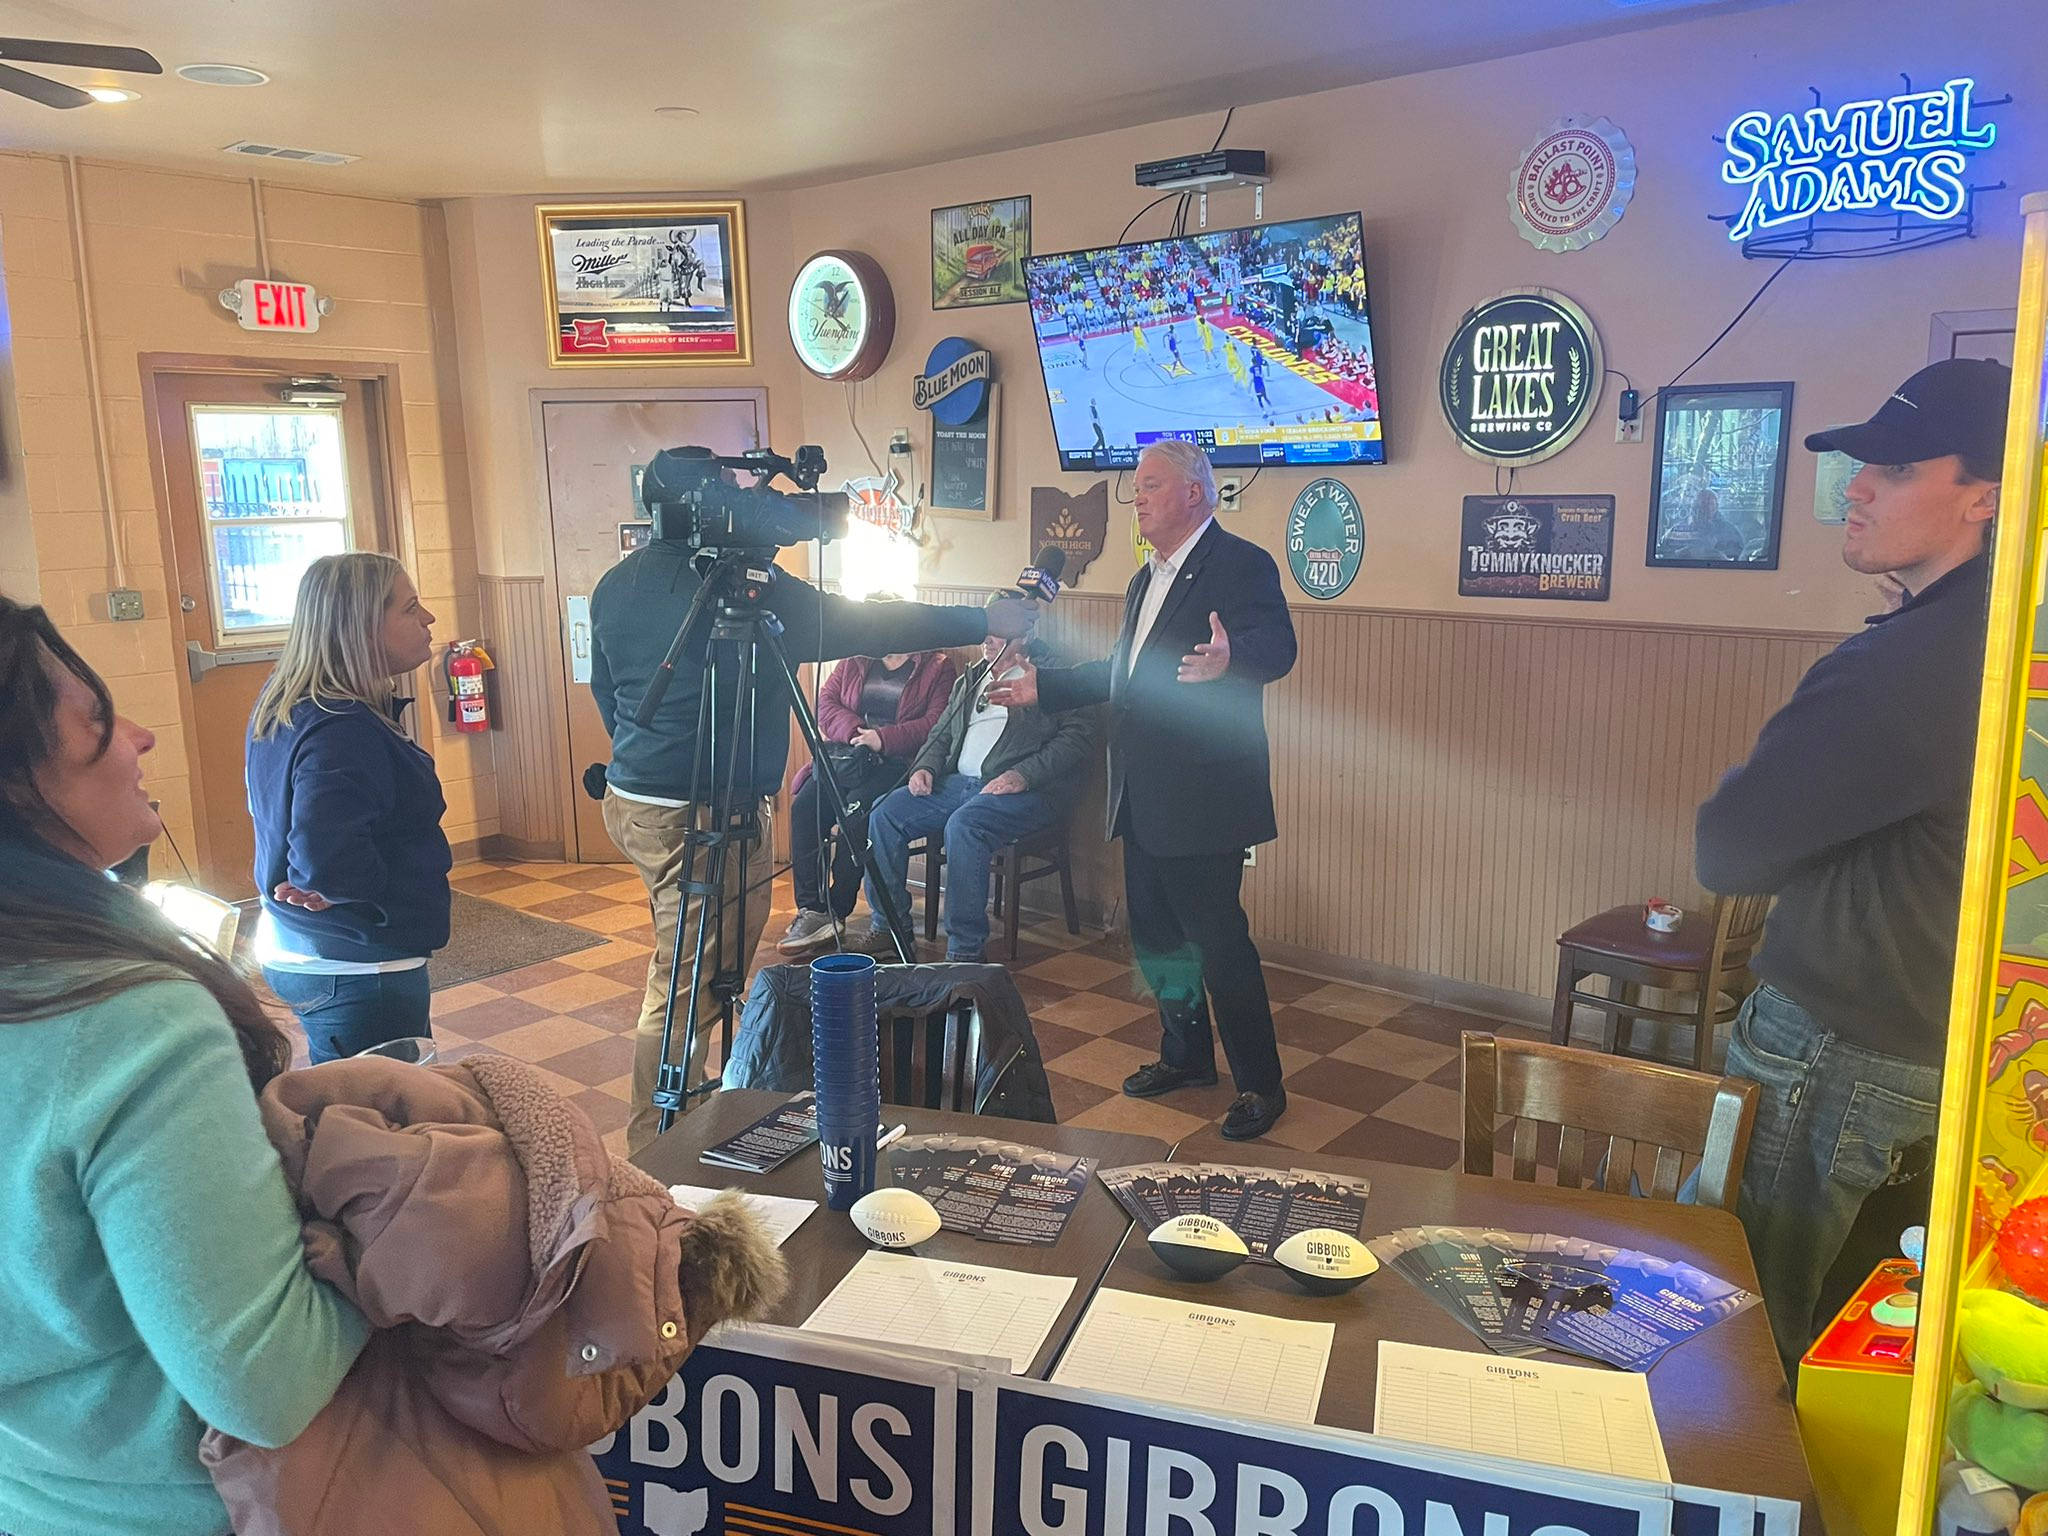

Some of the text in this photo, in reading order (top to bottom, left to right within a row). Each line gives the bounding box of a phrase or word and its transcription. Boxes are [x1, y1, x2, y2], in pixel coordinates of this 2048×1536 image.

[1722, 78, 1996, 184] SAMUEL
[1528, 140, 1605, 182] BALLAST POINT
[1528, 181, 1603, 223] DEDICATED TO THE CRAFT
[1728, 149, 1966, 241] ADAMS
[576, 238, 610, 252] Leading
[611, 237, 625, 246] the
[953, 225, 1006, 247] ALL DAY IPA
[960, 288, 988, 298] SESSION
[254, 282, 307, 328] EXIT
[613, 337, 626, 345] THE
[1473, 321, 1561, 373] GREAT
[915, 355, 984, 406] BLUE MOON
[1471, 372, 1555, 420] LAKES
[1470, 421, 1531, 433] BREWING
[1180, 433, 1193, 443] 12
[1290, 485, 1359, 554] SWEETWATER
[1068, 541, 1092, 550] HIGH
[1467, 546, 1604, 576] TOMMYKNOCKER
[1308, 562, 1338, 586] 420
[1539, 574, 1601, 591] BREWERY
[1031, 1173, 1069, 1186] GIBBONS
[867, 1226, 906, 1241] GIBBONS
[1177, 1217, 1220, 1233] GIBBONS
[1306, 1241, 1351, 1258] GIBBONS
[943, 1270, 987, 1284] GIBBONS
[1659, 1288, 1705, 1312] GIBBONS
[1188, 1312, 1236, 1328] GIBBONS
[1485, 1364, 1540, 1380] GIBBONS
